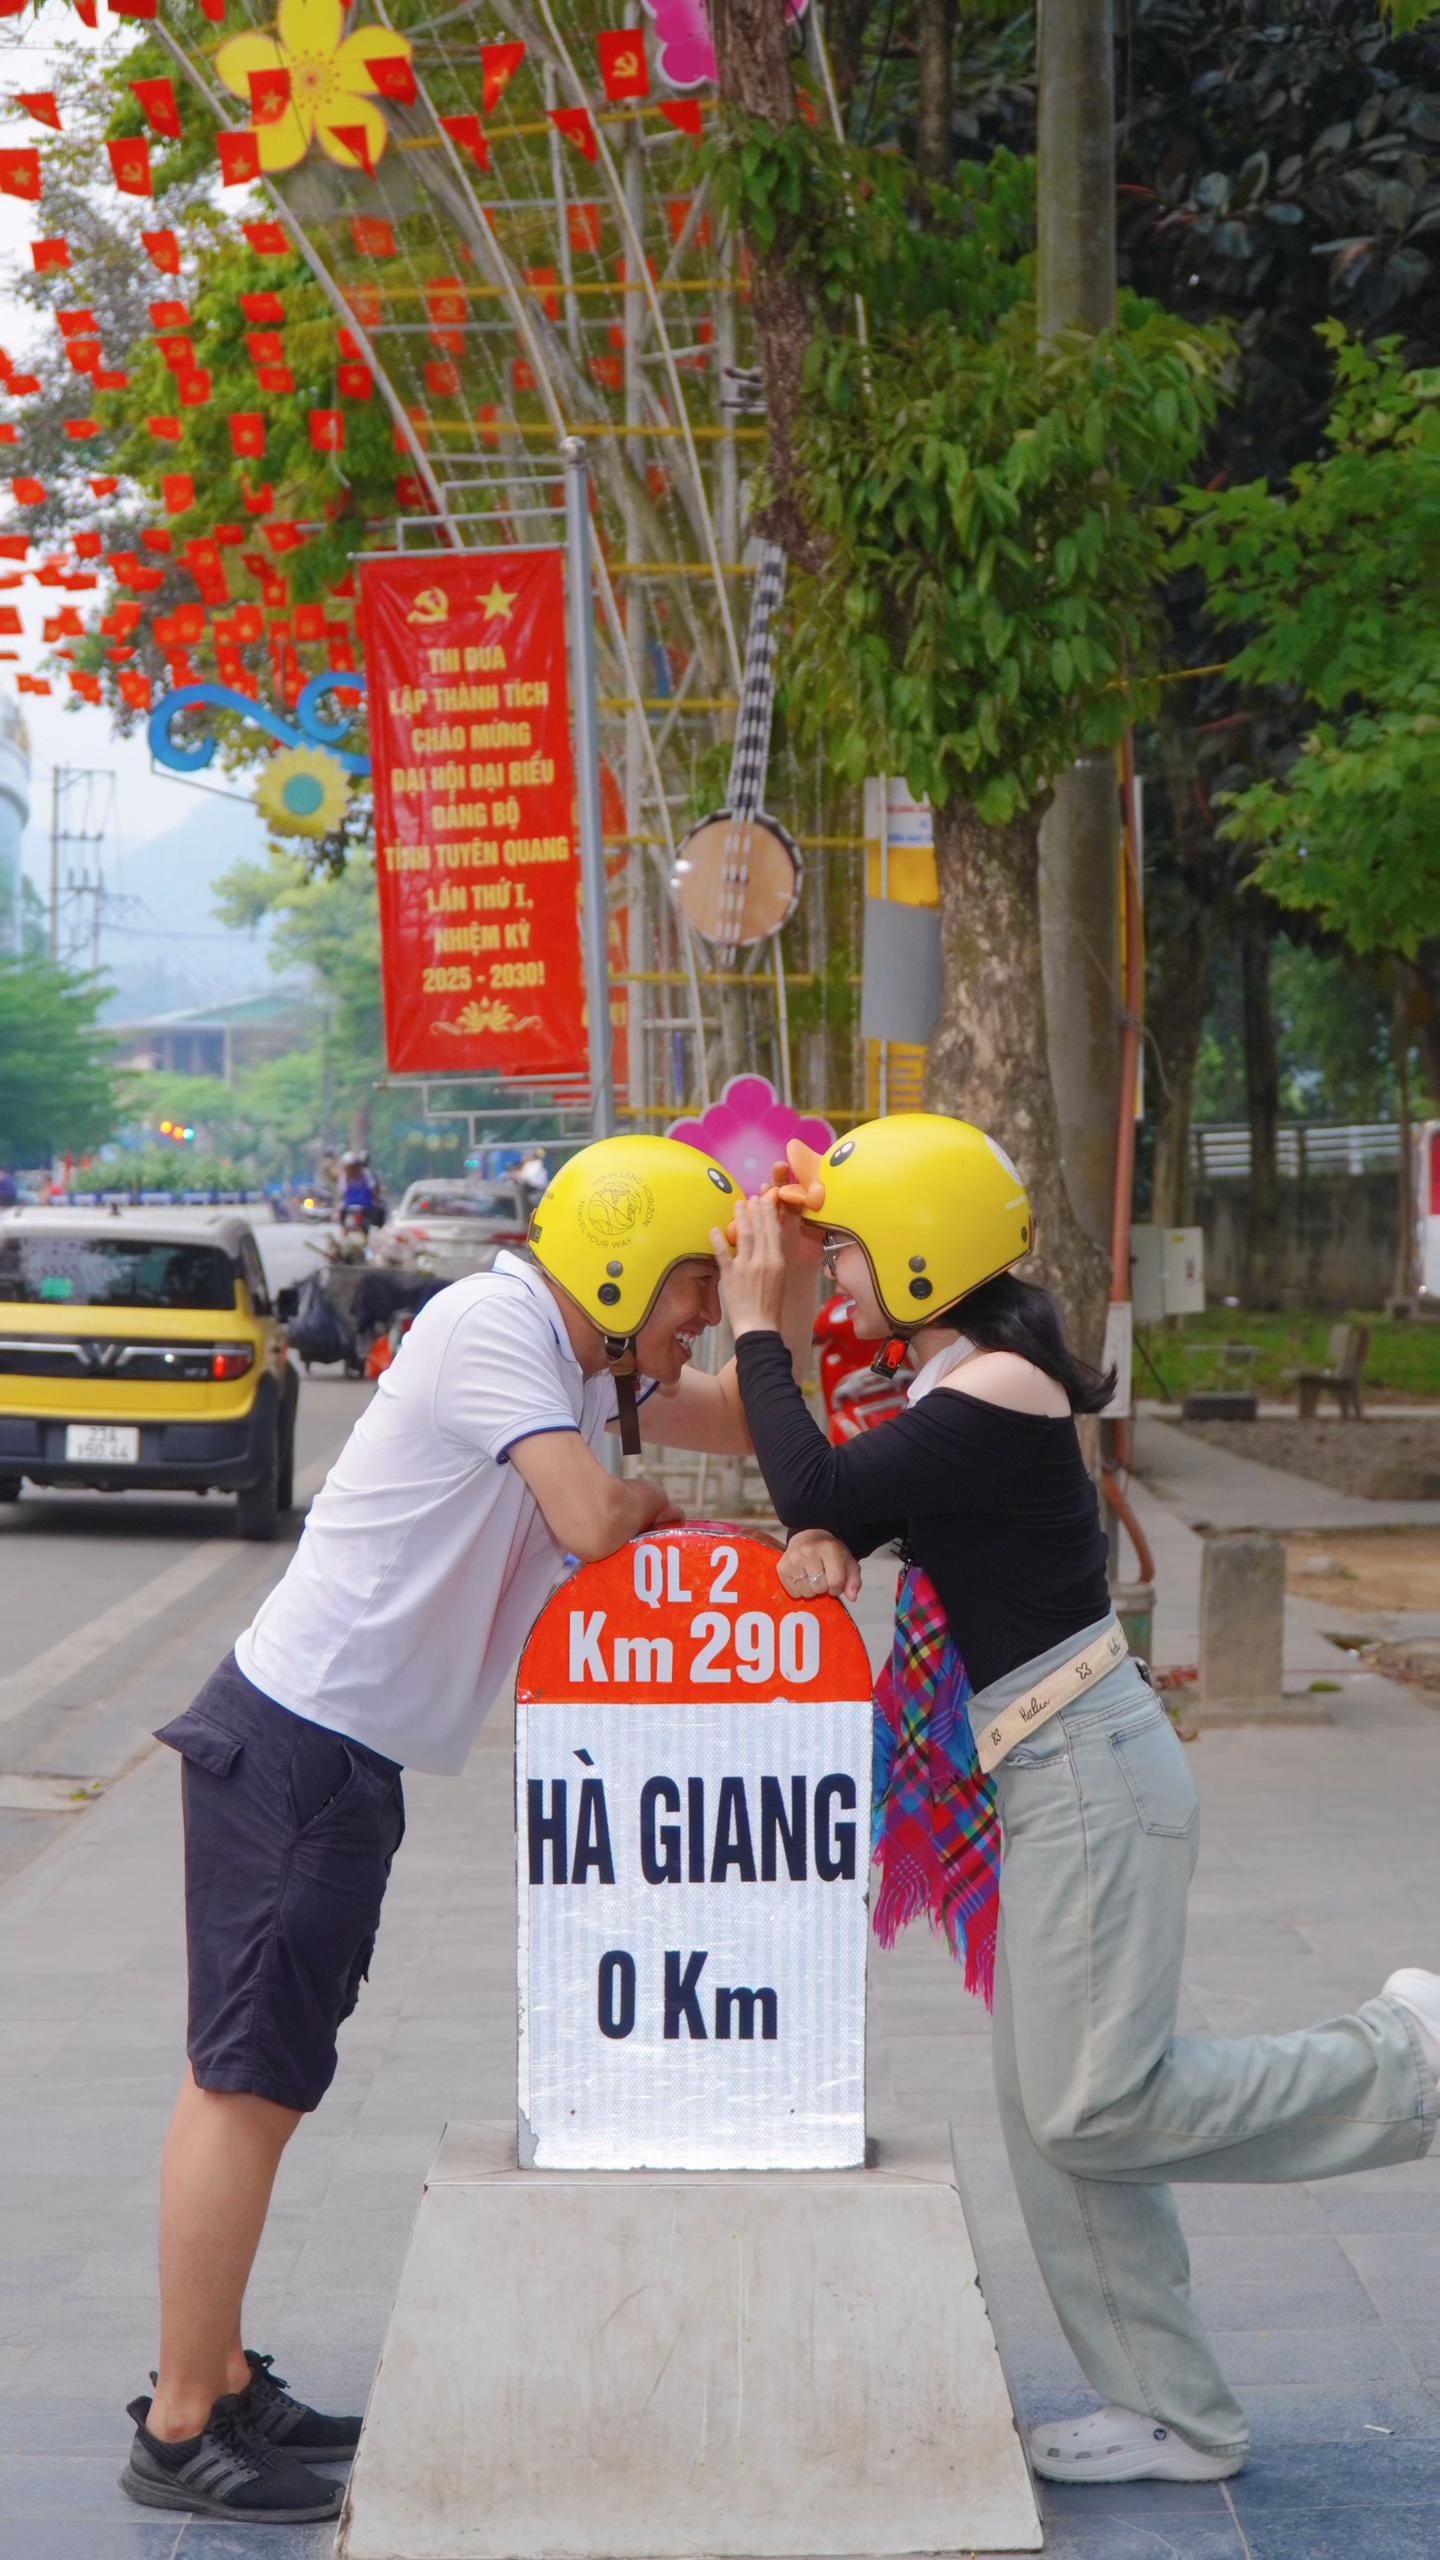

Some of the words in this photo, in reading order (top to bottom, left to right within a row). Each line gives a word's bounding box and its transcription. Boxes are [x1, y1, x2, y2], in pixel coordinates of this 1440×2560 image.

[428, 648, 460, 673] THI
[464, 645, 506, 672] ĐUA
[389, 685, 427, 718] LẬP
[432, 681, 498, 711] THÀNH
[503, 677, 548, 708] TÍCH
[412, 722, 466, 752] CHÀO
[471, 718, 531, 749] MỪNG
[391, 768, 426, 797] ĐẠI
[431, 760, 465, 794] HỘI
[470, 762, 504, 793] ĐẠI
[509, 750, 555, 786] BIỂU
[493, 796, 520, 831] BỘ
[435, 837, 498, 867] TUYÊN
[503, 835, 569, 867] QUANG
[471, 877, 511, 911] THỨ
[434, 921, 499, 956] NHIỆM
[423, 966, 471, 993] 2025
[490, 961, 545, 989] 2030!
[633, 1544, 692, 1608] QL
[709, 1546, 739, 1604] 2
[569, 1611, 673, 1682] Km
[690, 1611, 820, 1683] 290
[528, 1748, 616, 1884] HÀ
[640, 1773, 857, 1884] GIANG
[663, 1951, 778, 2039] Km
